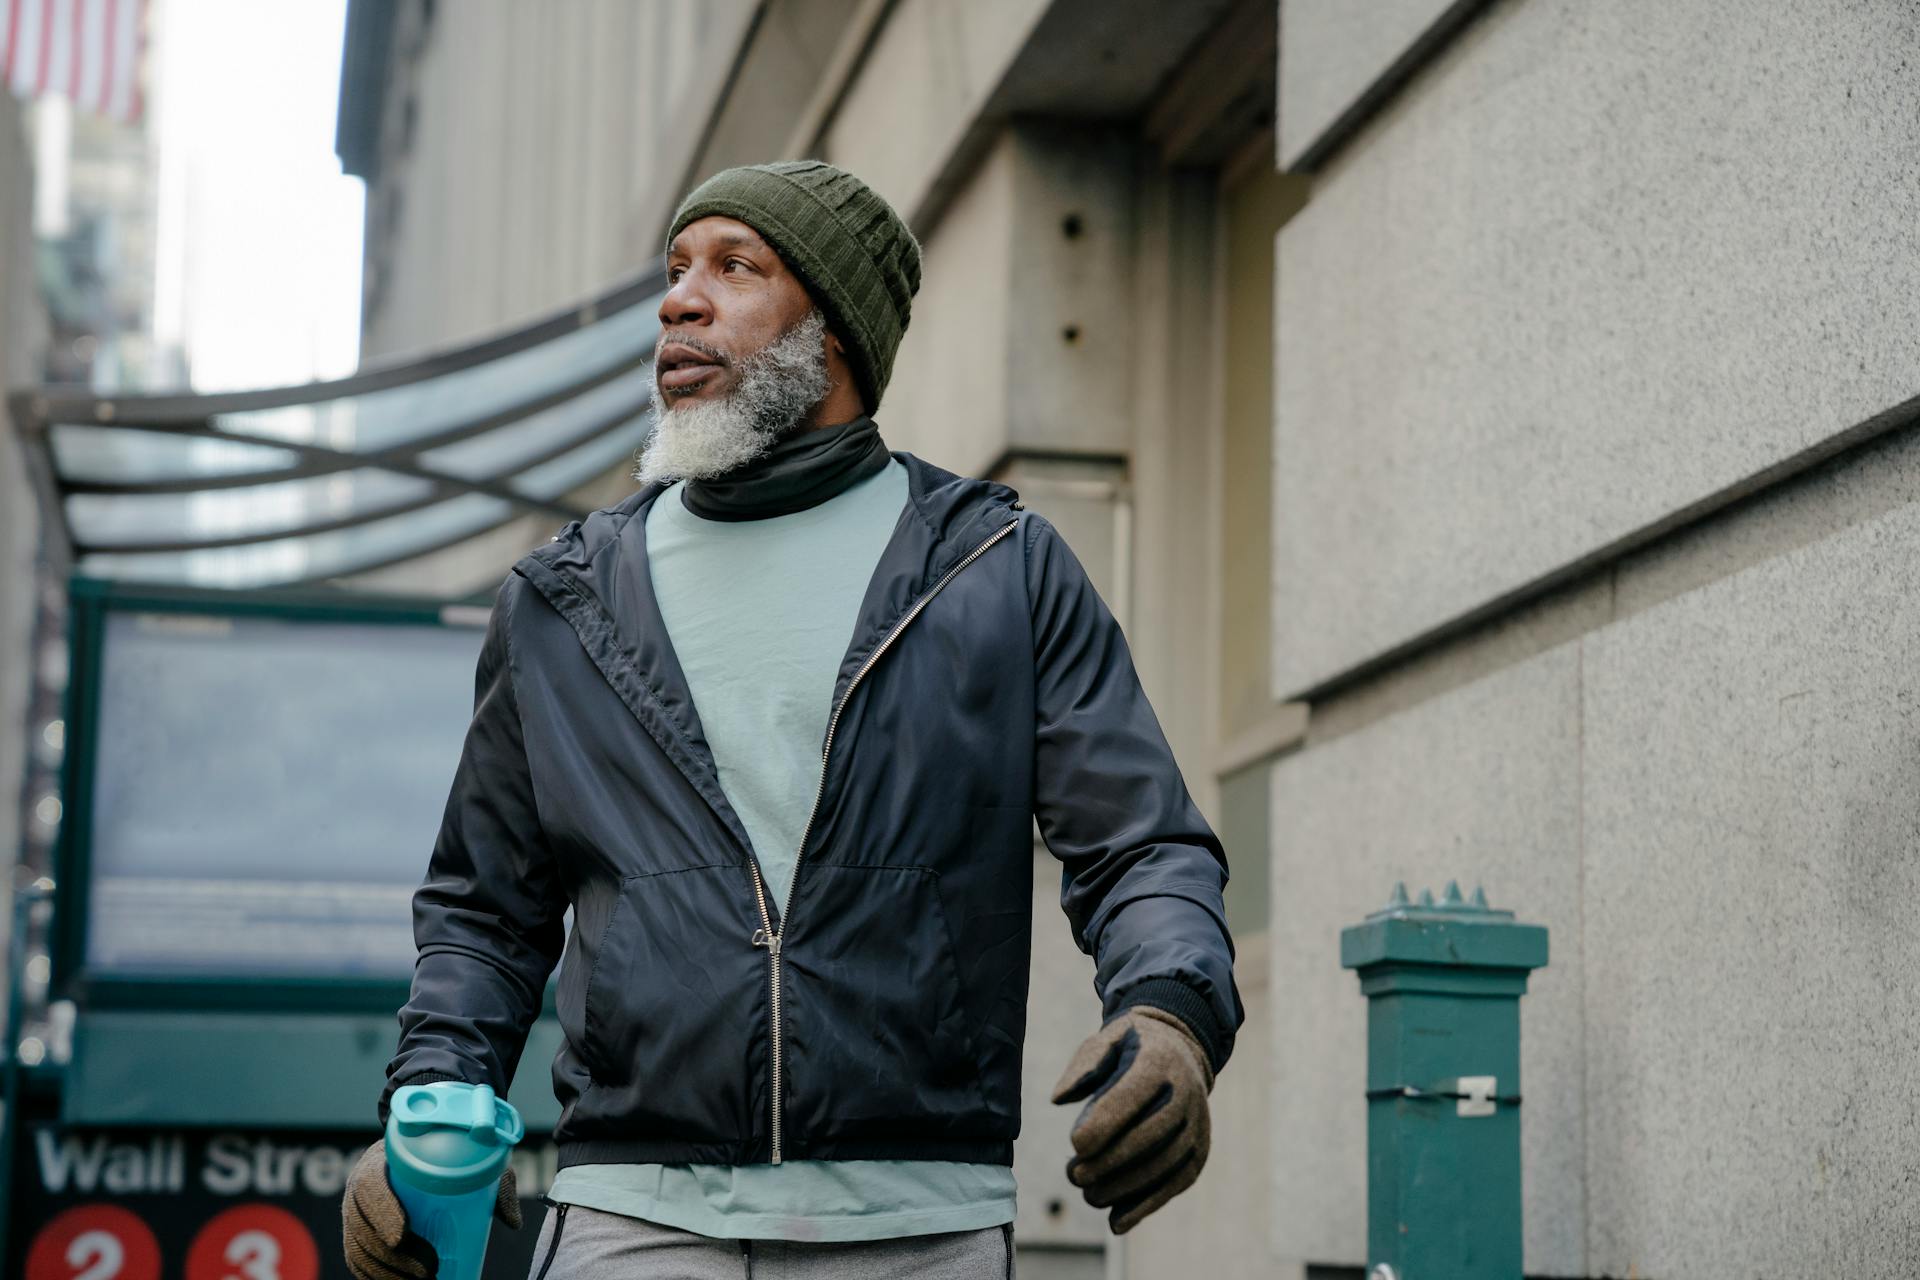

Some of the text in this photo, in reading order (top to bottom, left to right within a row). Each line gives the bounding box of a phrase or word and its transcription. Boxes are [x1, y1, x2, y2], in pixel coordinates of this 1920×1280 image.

[36, 1128, 365, 1195] Wall Stre
[66, 1230, 282, 1280] 2 3
